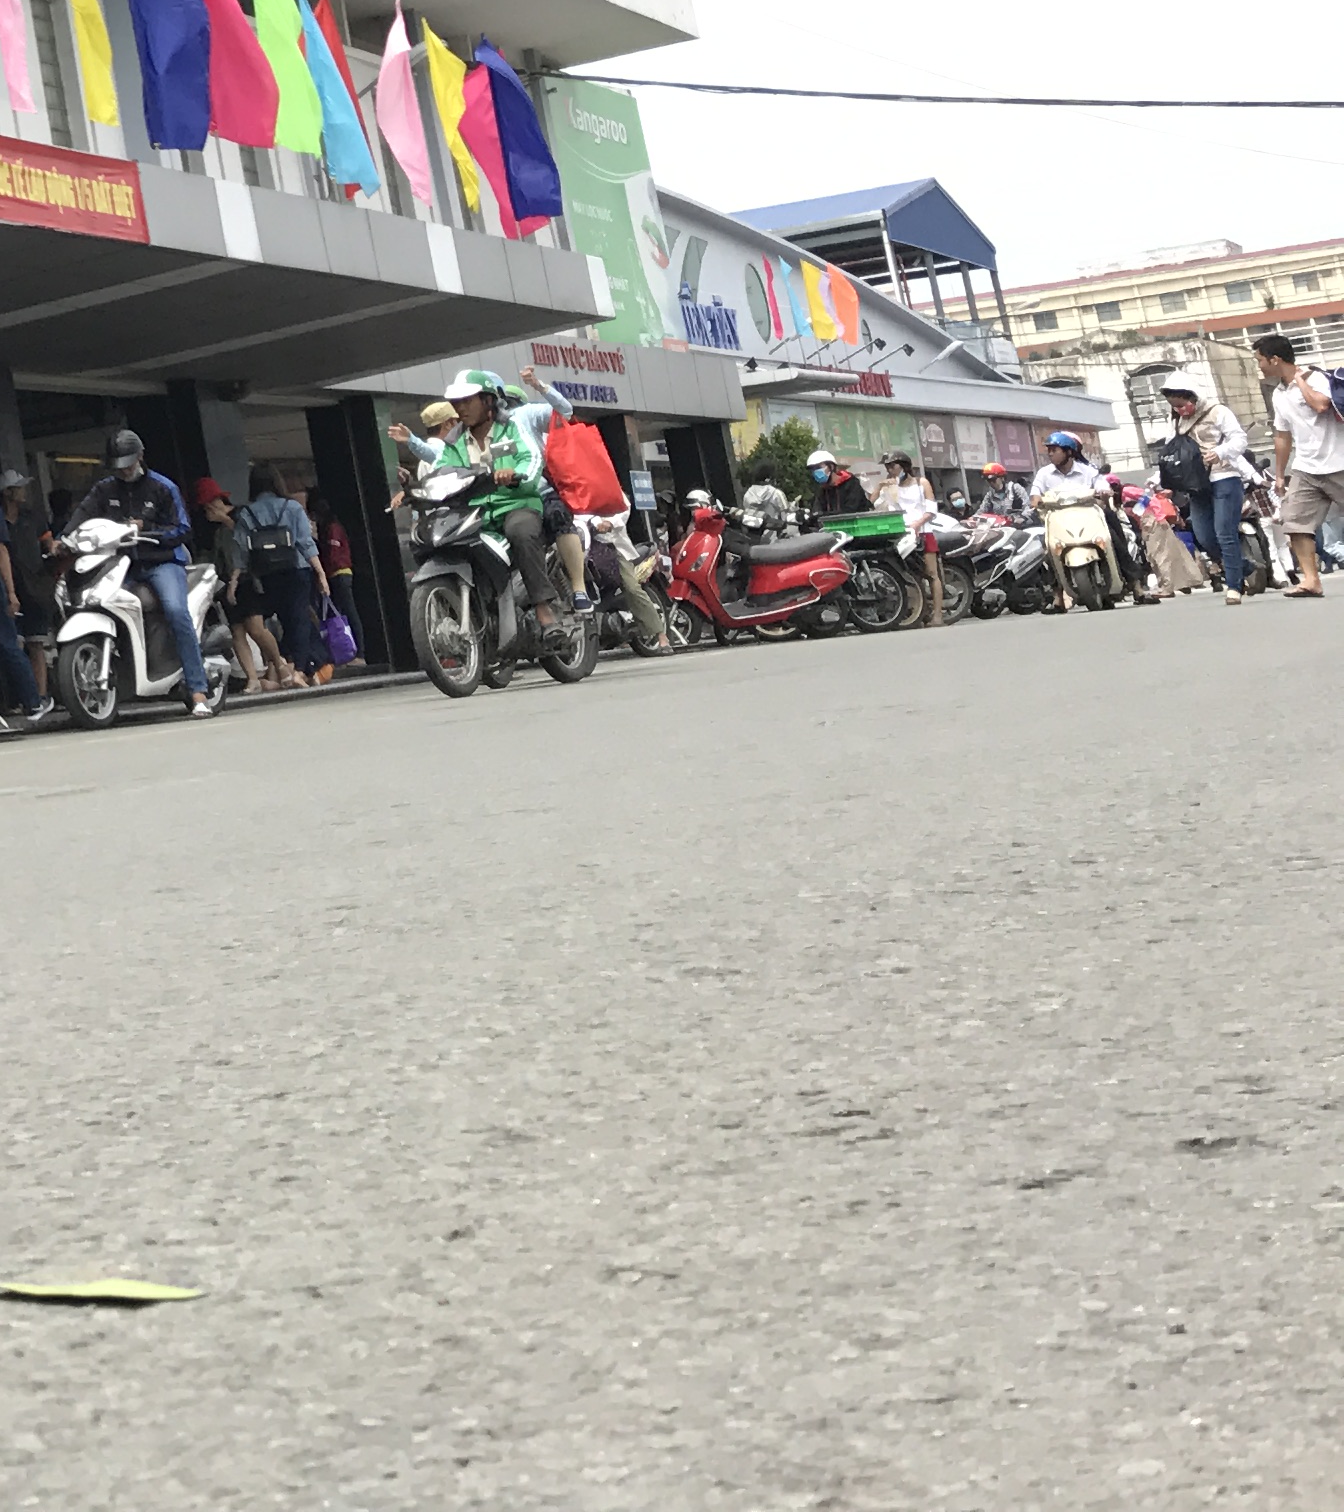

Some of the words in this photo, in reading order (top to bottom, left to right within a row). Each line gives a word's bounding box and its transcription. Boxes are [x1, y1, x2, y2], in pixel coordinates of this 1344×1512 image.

[563, 96, 628, 144] Kangaroo
[531, 342, 560, 367] KHU
[559, 343, 585, 376] VỰC
[584, 345, 610, 372] BÁN
[590, 384, 618, 404] AREA
